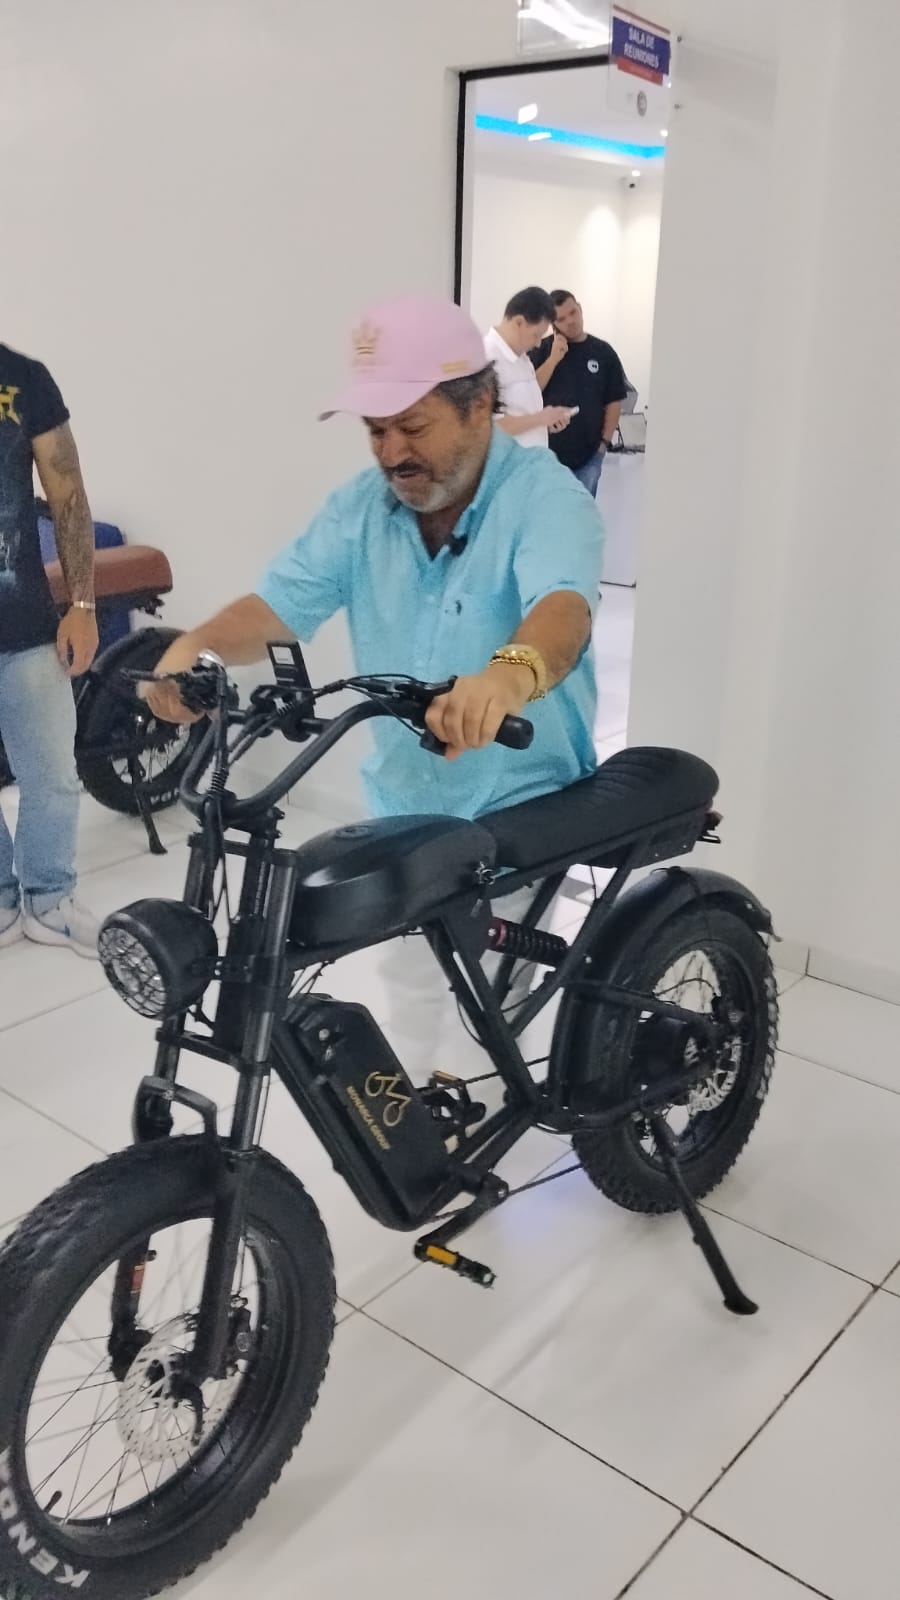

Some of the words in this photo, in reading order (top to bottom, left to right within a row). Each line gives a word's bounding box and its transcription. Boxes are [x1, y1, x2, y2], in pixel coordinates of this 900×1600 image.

[628, 27, 646, 46] SALA
[646, 35, 655, 50] DE
[346, 1085, 374, 1126] MONARCA
[370, 1124, 391, 1150] GROUP
